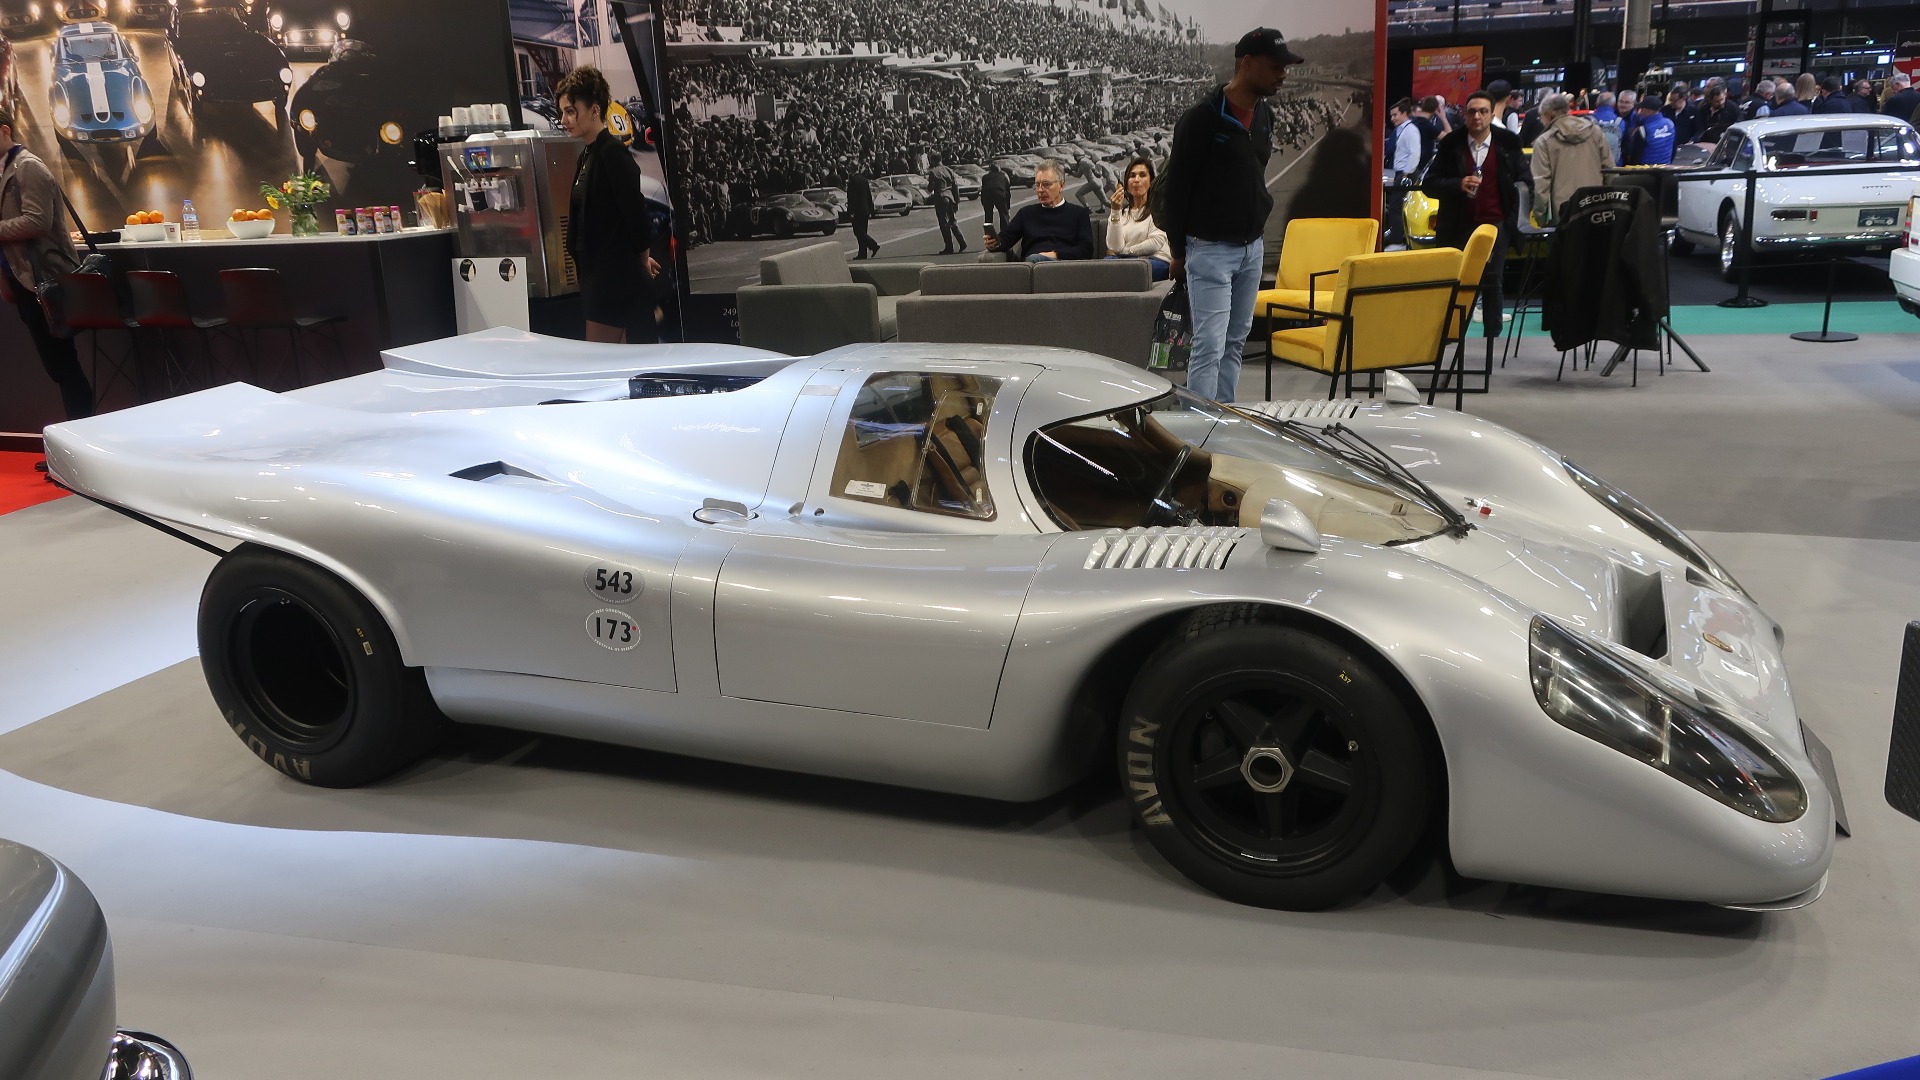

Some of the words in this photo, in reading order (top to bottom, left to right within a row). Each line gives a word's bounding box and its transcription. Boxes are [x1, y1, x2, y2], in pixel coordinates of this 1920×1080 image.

[1578, 191, 1630, 208] SÉCURITÉ
[723, 308, 737, 316] 249
[595, 568, 633, 594] 543
[595, 617, 632, 643] 173
[1338, 673, 1352, 684] A37
[225, 709, 312, 780] AVON
[1127, 717, 1174, 825] AVON
